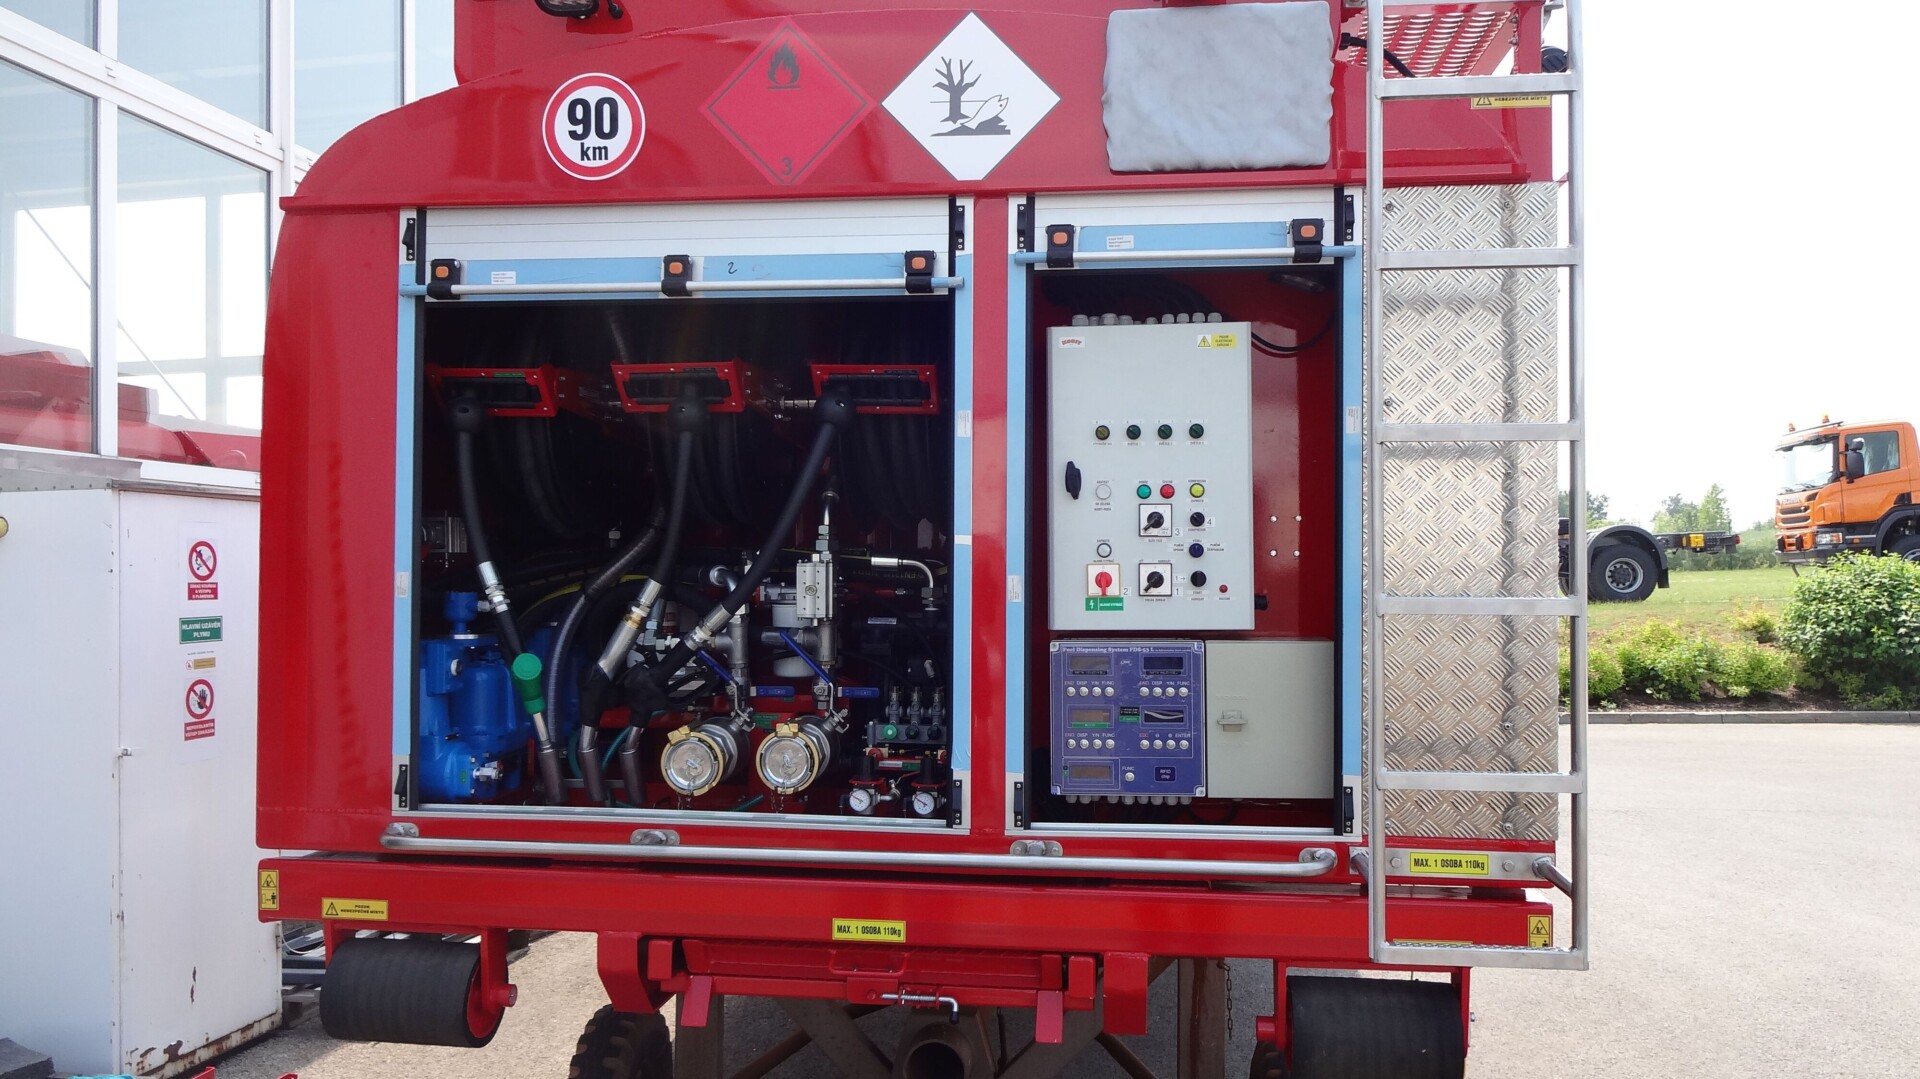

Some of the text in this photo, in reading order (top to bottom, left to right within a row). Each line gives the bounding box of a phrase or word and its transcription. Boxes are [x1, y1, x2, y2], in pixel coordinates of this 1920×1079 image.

[567, 96, 619, 140] 90
[580, 142, 609, 162] km
[781, 158, 793, 176] 3
[1174, 528, 1180, 536] 3
[1123, 588, 1128, 596] 2
[202, 621, 220, 629] UZÁVĚR
[1414, 858, 1485, 870] MAX. 1 OSOBA 110kg
[836, 924, 902, 938] MAX. 1 OSOBA 110kg
